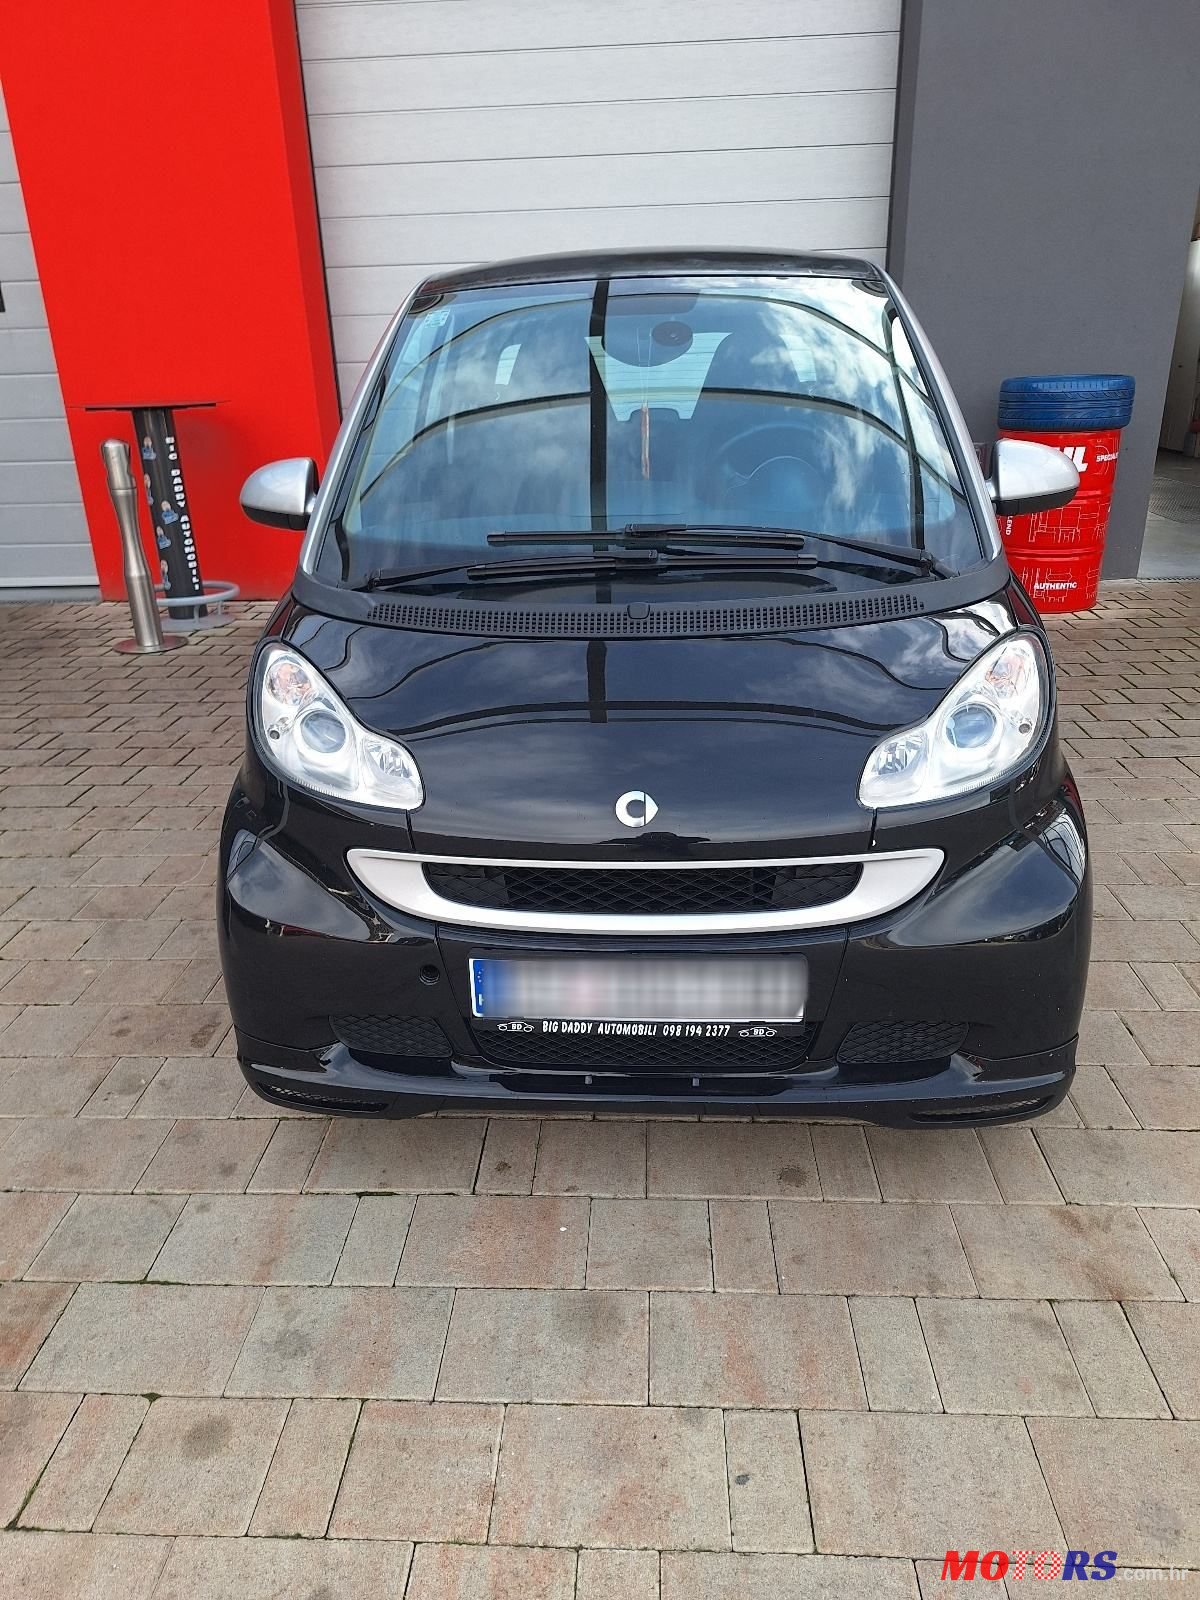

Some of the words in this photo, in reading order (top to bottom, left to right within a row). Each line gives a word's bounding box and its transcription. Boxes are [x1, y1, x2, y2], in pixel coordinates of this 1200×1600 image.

[165, 436, 178, 461] BIG
[171, 468, 186, 508] DADDY
[180, 514, 200, 591] AUTOMOBILI
[1033, 581, 1078, 590] AUTHENTIC
[542, 1020, 559, 1033] BIG
[561, 1021, 593, 1034] DADDY
[597, 1022, 658, 1036] AUTOMOBILI
[663, 1024, 682, 1037] 098
[685, 1024, 703, 1037] 194
[705, 1024, 731, 1037] 2377
